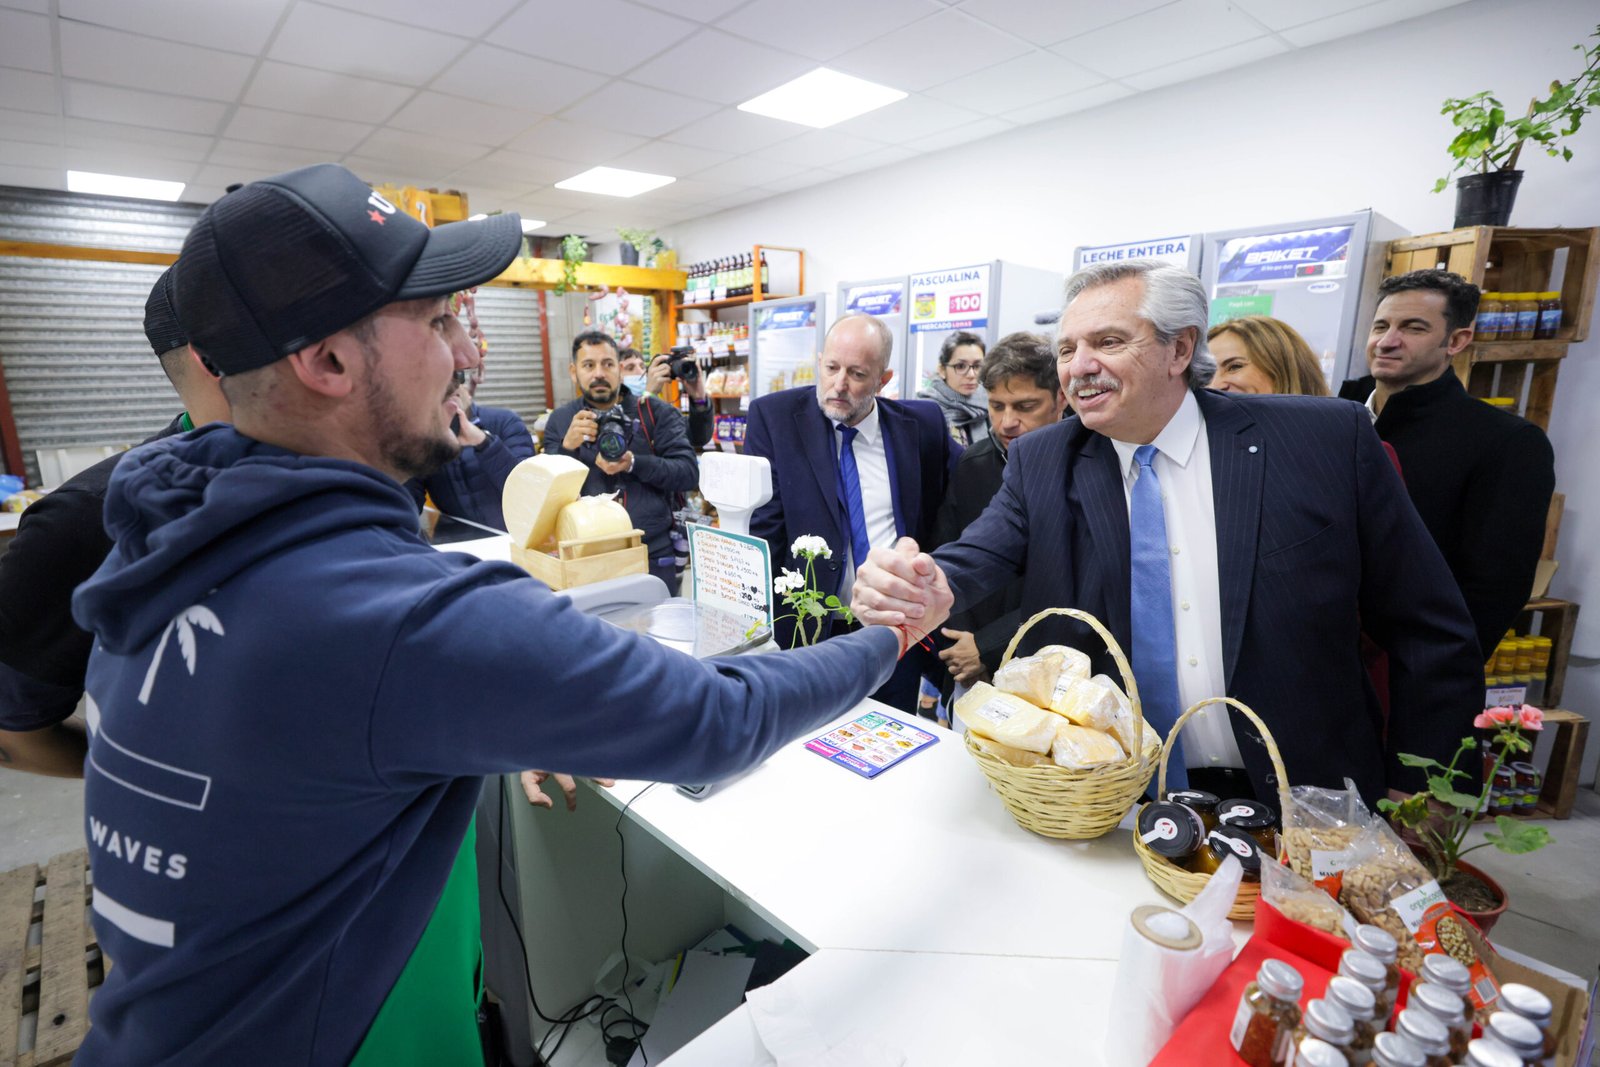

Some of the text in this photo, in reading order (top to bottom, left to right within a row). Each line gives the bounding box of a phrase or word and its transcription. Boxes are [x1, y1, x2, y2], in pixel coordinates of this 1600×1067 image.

[1083, 242, 1186, 264] LECHE ENTERA
[1244, 246, 1319, 264] BRIKET
[912, 270, 980, 287] PASCUALINA
[950, 295, 980, 311] $100
[89, 815, 188, 880] WAVES
